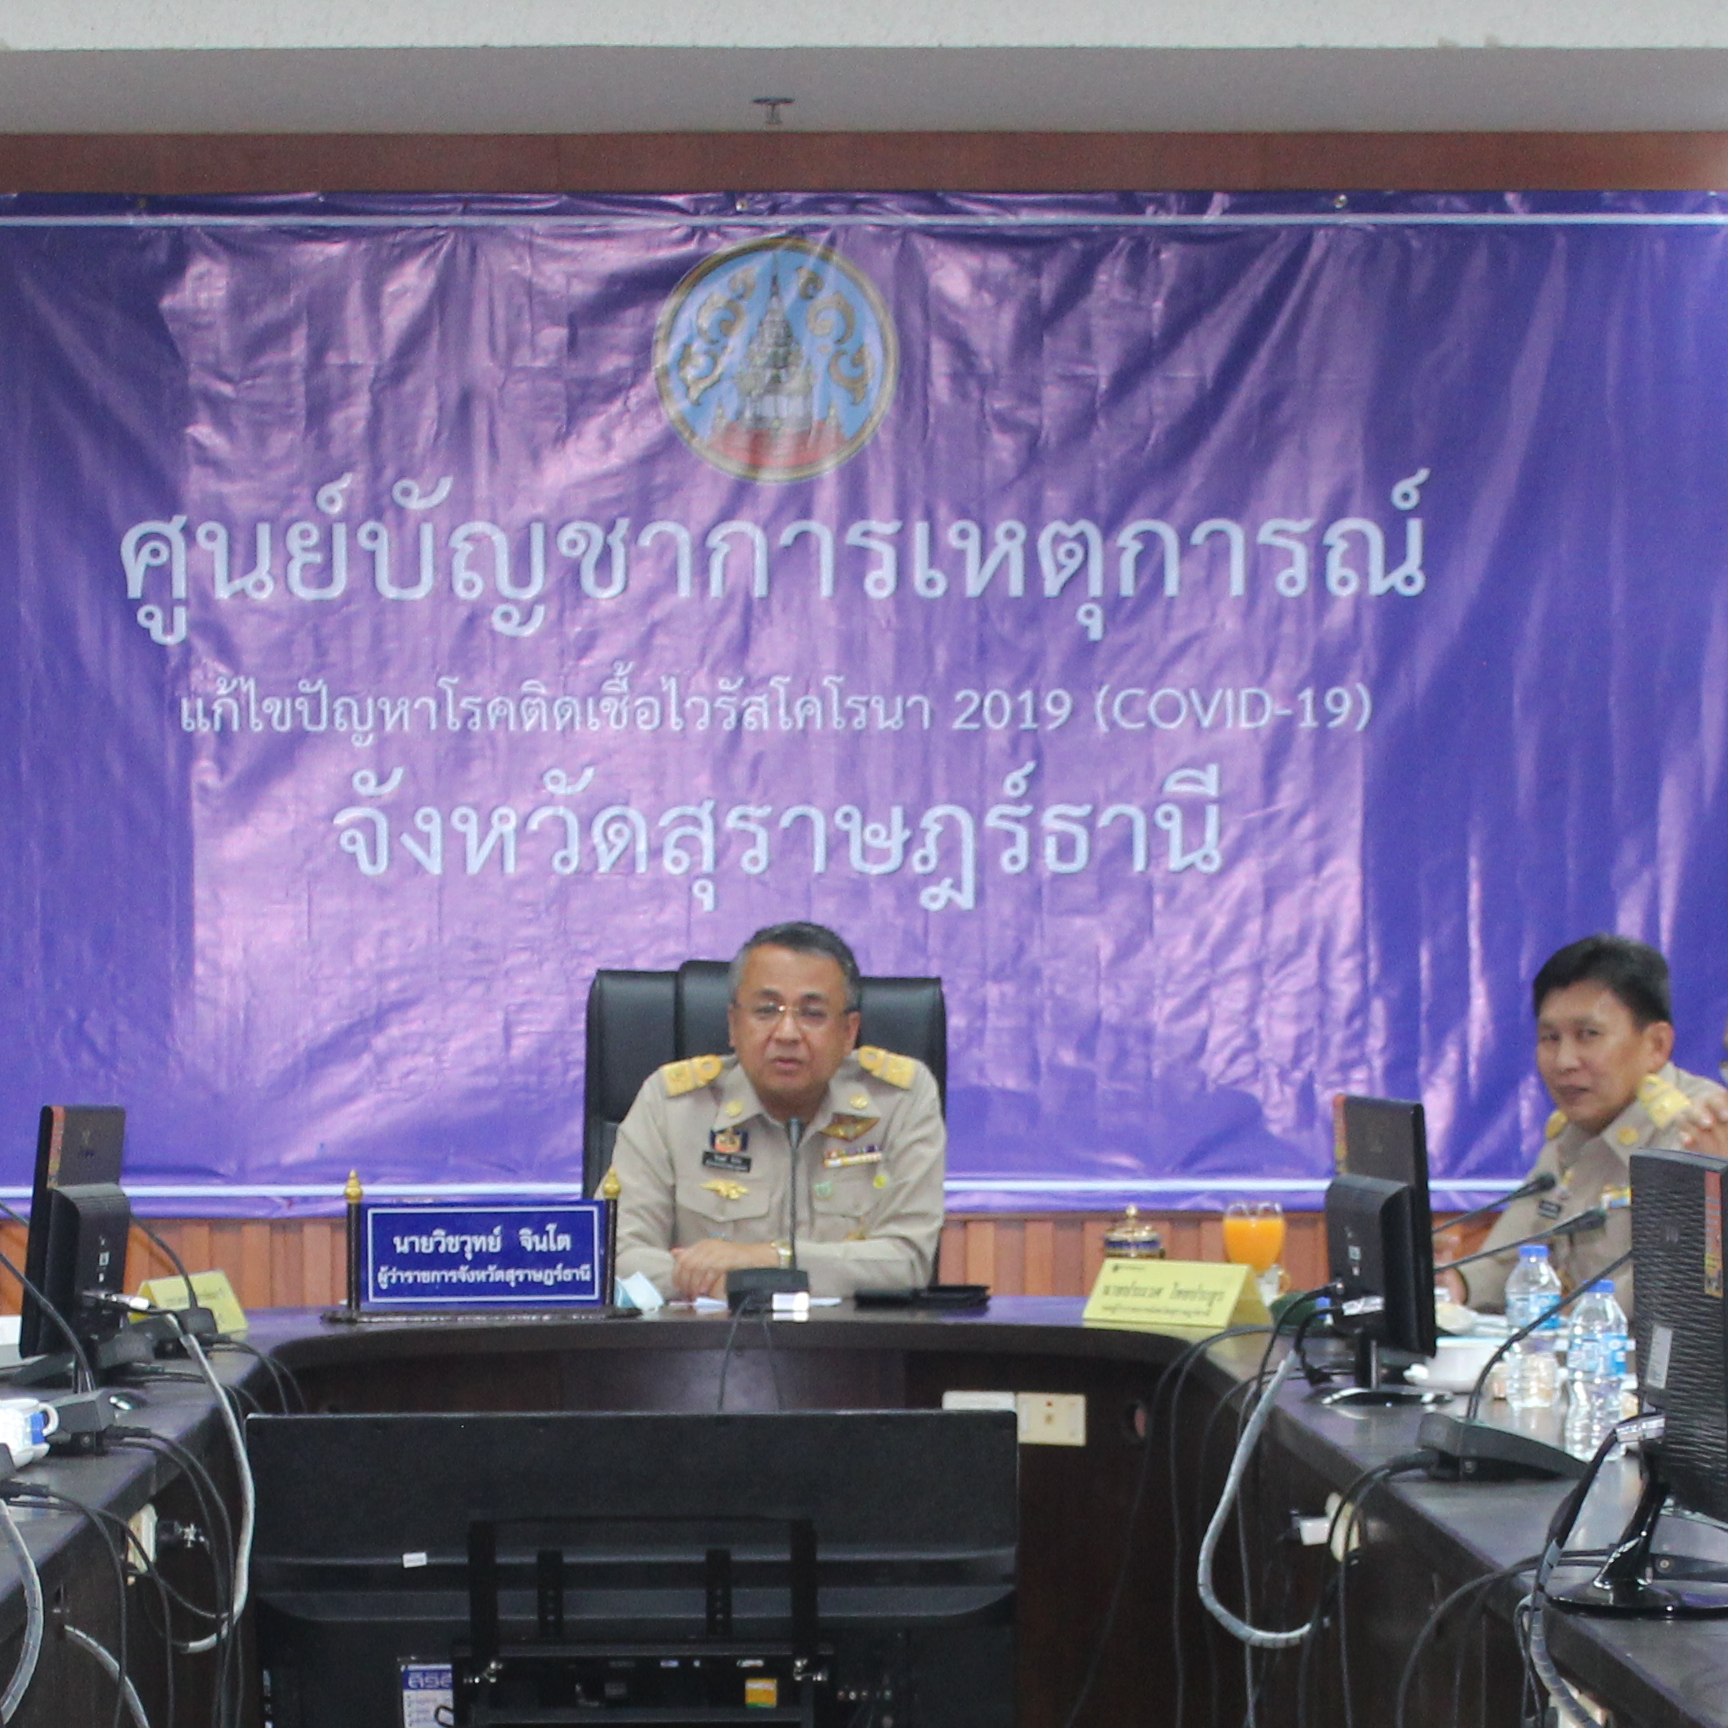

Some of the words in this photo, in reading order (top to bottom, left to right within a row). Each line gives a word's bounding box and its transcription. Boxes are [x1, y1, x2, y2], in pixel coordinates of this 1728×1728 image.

[119, 470, 1430, 645] ศูนย์บัญชาการเหตุการณ์
[178, 661, 933, 748] แก้ไขปัญหาโรคติดเชื้อไวรัสโคโรนา
[952, 688, 1073, 732] 2019
[1094, 682, 1373, 734] (COVID-19)
[332, 761, 1224, 913] จังหวัดสุราษฎร์ธานี
[378, 1263, 592, 1289] ผู้ว่าราชการจังหวัดสุราษฎร์ธานี
[393, 1226, 503, 1260] นายวิชวุทย์
[518, 1223, 572, 1252] จินโต
